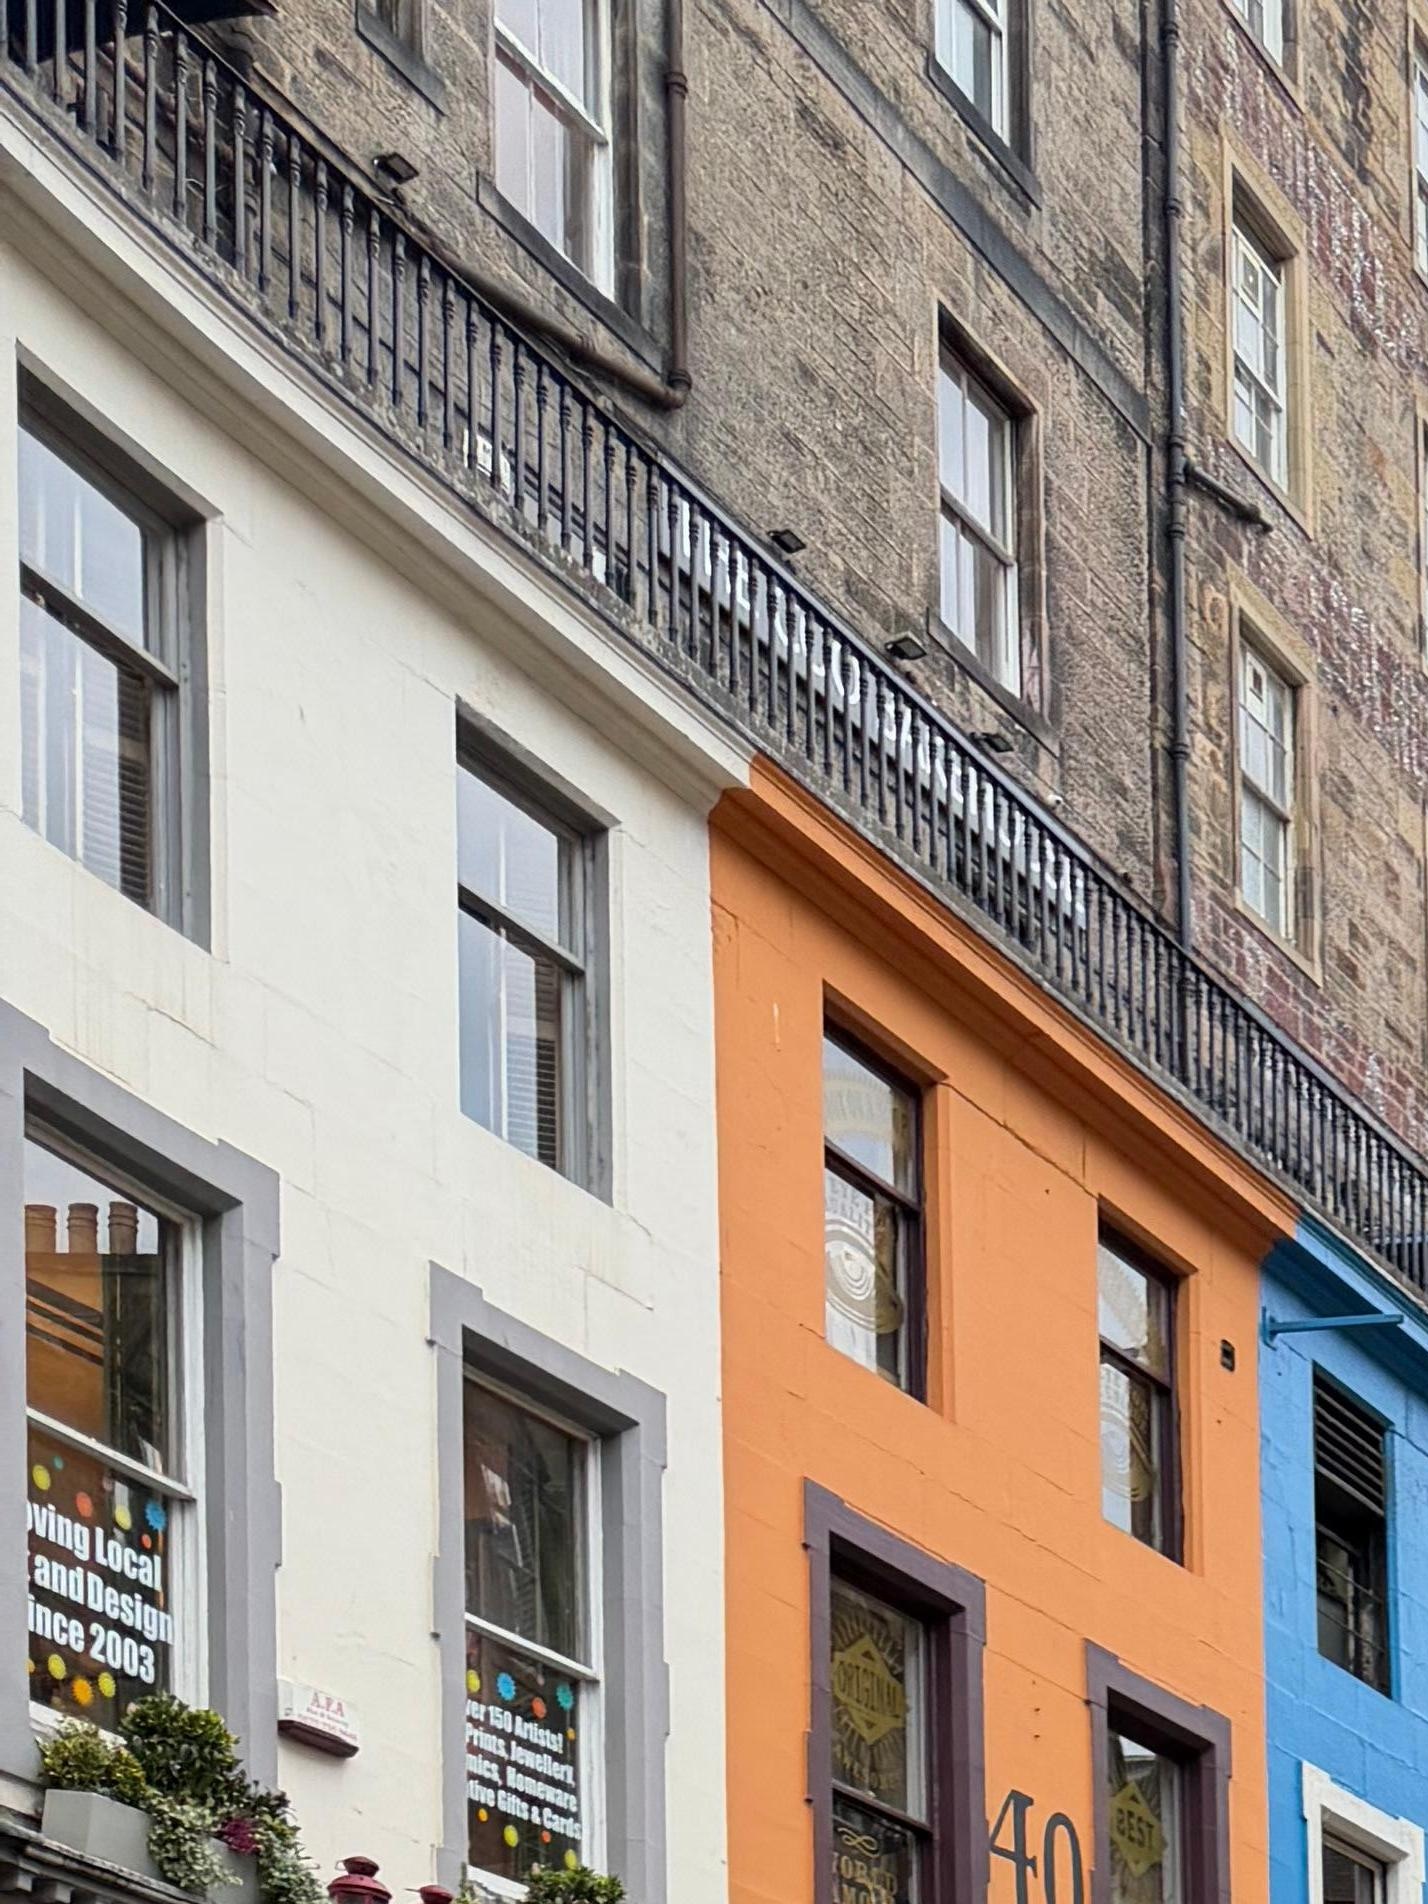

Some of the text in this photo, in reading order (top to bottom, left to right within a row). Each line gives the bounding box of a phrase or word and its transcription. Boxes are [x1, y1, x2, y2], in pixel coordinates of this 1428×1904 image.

[95, 1526, 162, 1592] Local
[34, 1555, 174, 1645] and Design
[89, 1622, 156, 1685] 2003
[488, 1705, 513, 1733] 150
[514, 1715, 564, 1754] Artists!
[510, 1740, 576, 1788] Jewellery,
[497, 1789, 530, 1821] Gifts
[530, 1805, 542, 1825] &
[542, 1807, 583, 1840] Cards
[506, 1766, 578, 1813] Homeware
[1115, 1807, 1154, 1851] BEST
